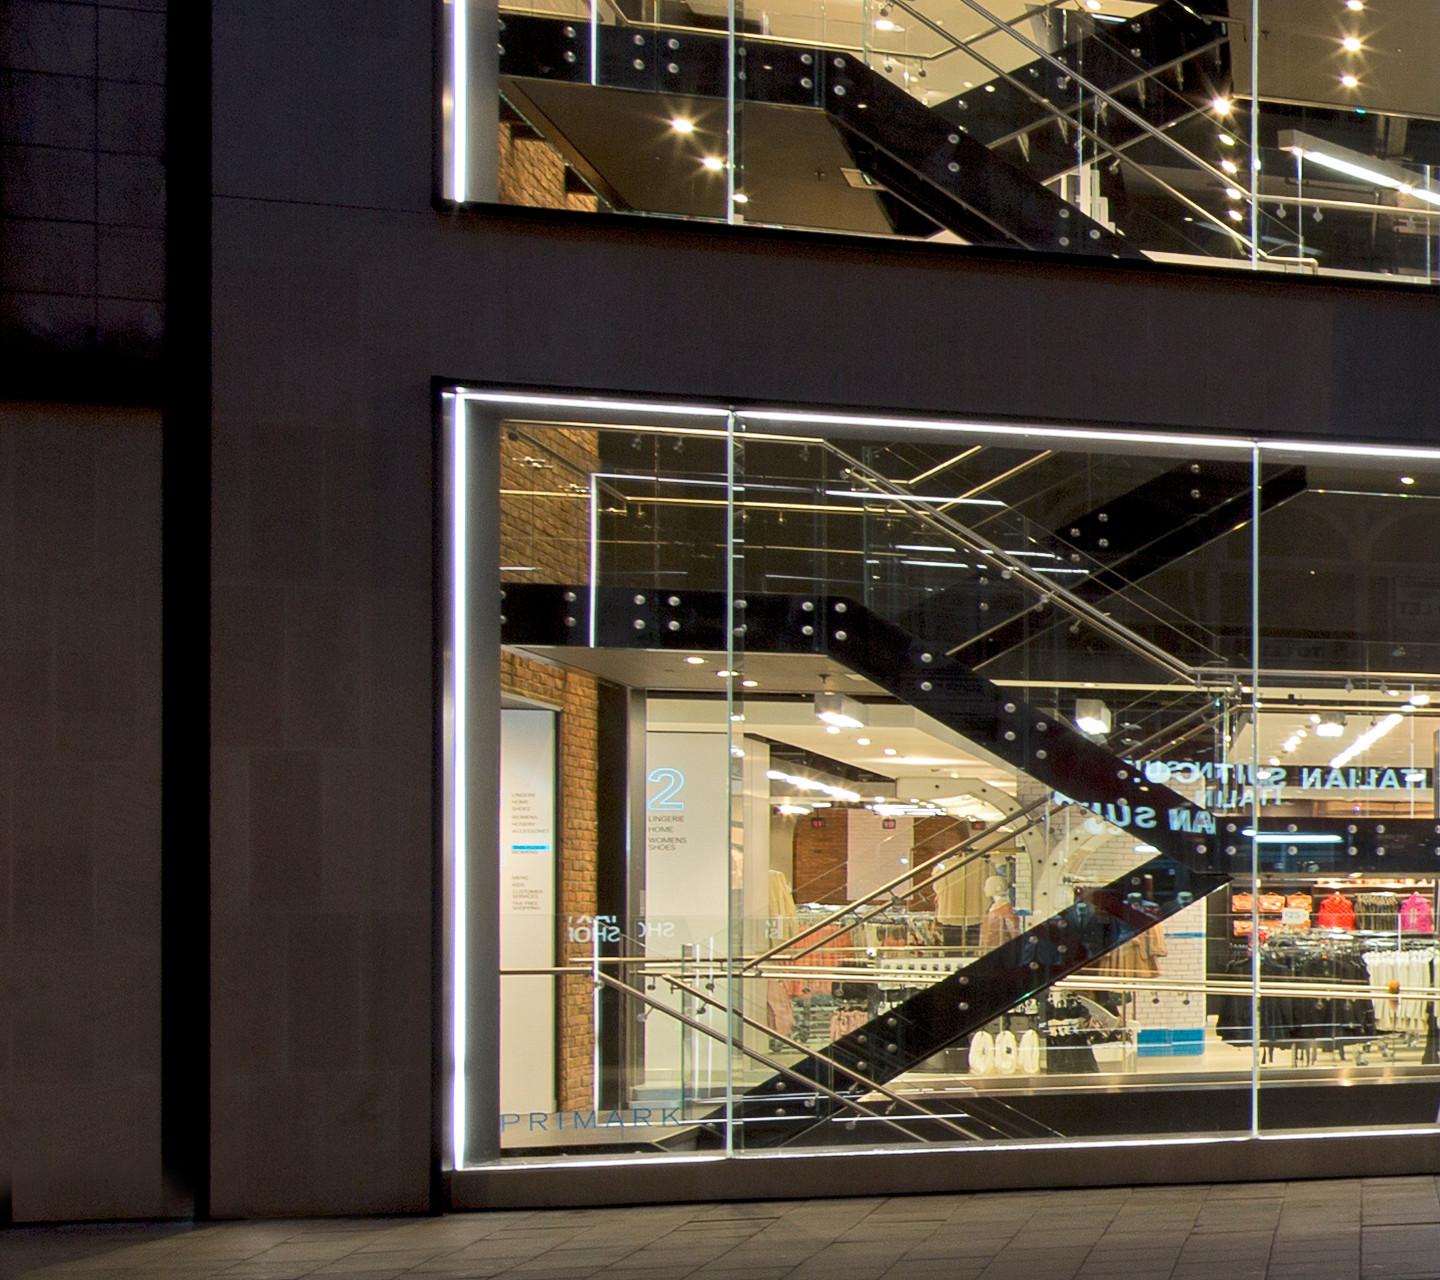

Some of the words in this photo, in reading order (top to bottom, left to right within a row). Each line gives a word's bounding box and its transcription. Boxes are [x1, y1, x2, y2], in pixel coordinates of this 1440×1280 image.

[646, 767, 686, 812] 2
[647, 815, 685, 823] LINGERIE
[647, 836, 688, 844] WOMENS
[647, 843, 677, 851] SHOES
[501, 1106, 684, 1133] PRIMARK
